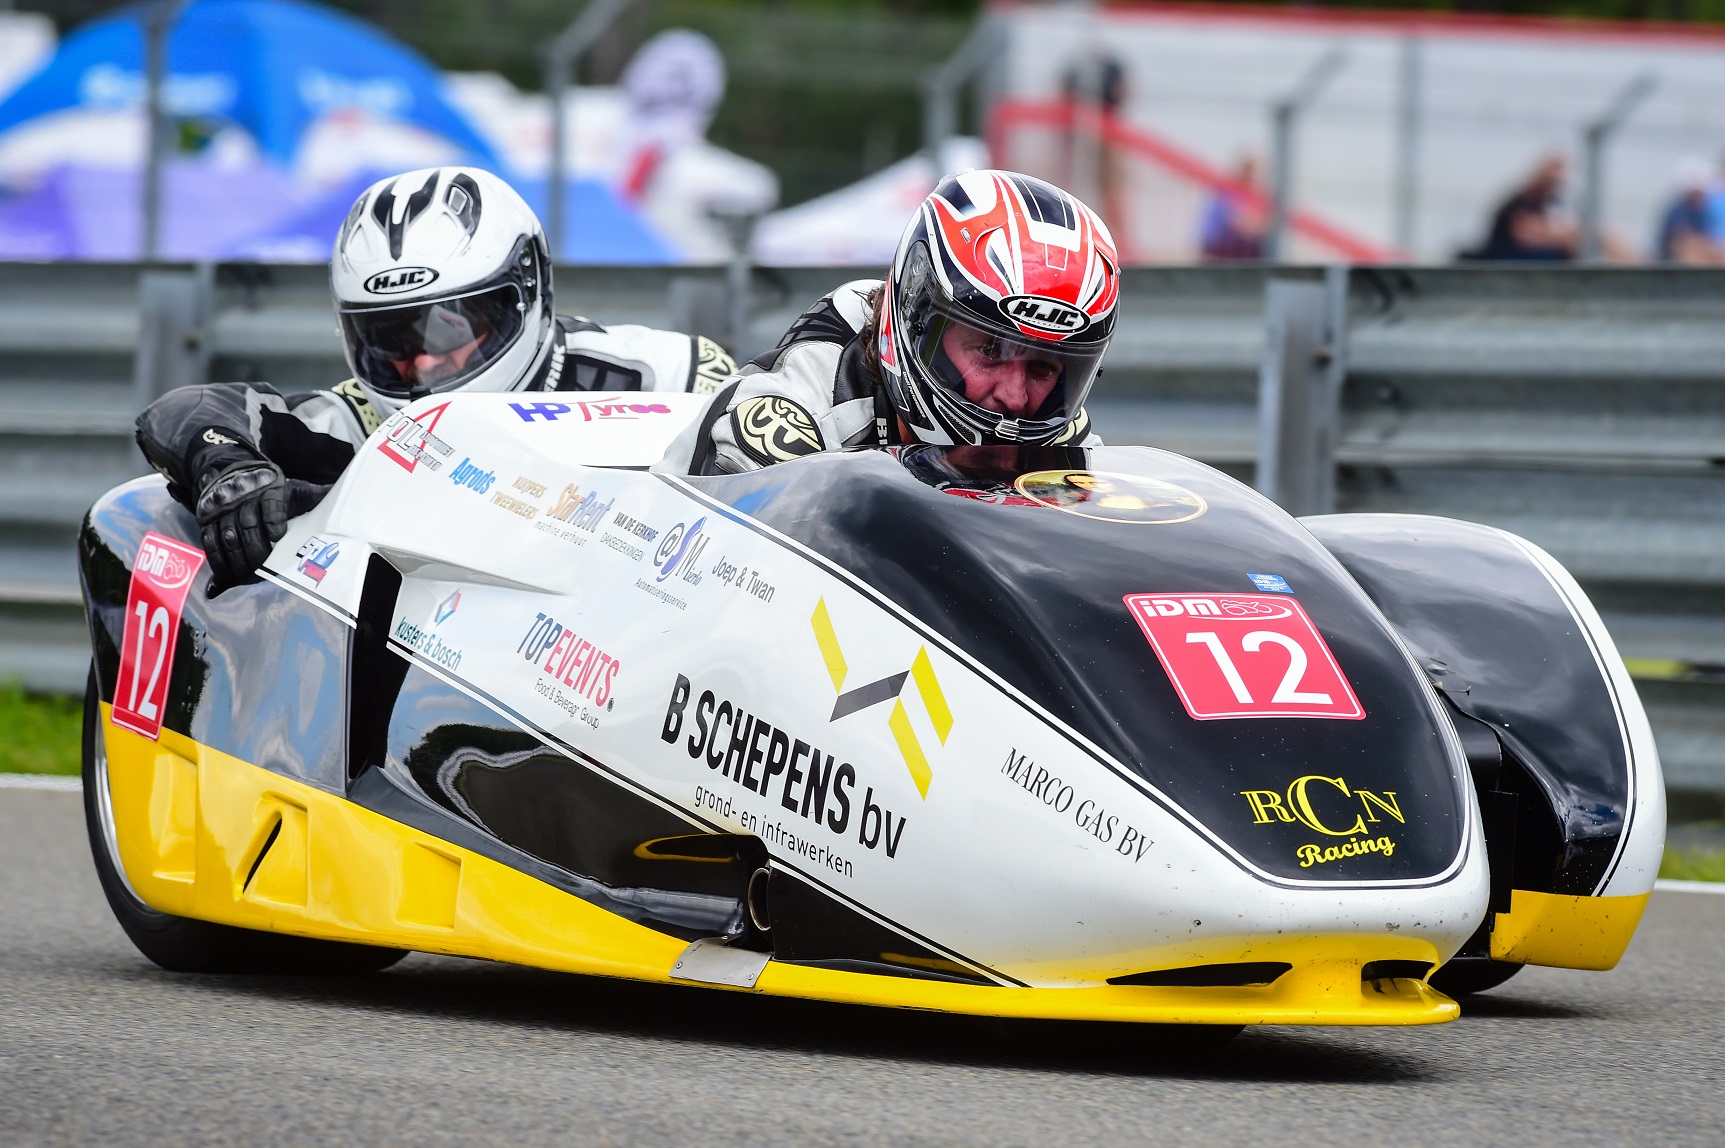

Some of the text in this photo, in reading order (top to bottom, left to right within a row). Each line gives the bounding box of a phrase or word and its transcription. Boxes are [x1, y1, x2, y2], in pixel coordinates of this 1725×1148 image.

[373, 270, 425, 290] HJC
[1012, 300, 1079, 327] HJC
[507, 396, 671, 423] HP Tyres
[613, 511, 630, 528] VAN
[711, 555, 776, 603] Joep & Twan
[1138, 599, 1223, 618] iDM
[128, 599, 171, 721] 12
[394, 616, 463, 672] kusters & bosch
[1185, 630, 1333, 705] 12
[534, 677, 552, 697] Food
[548, 686, 557, 700] &
[580, 706, 600, 730] Group
[661, 672, 907, 860] B SCHEPENS bv
[694, 784, 854, 879] grond- en infrawerken
[1000, 746, 1155, 864] MARCO GAS BV
[1239, 775, 1406, 836] RCN
[1296, 836, 1396, 868] Racing
